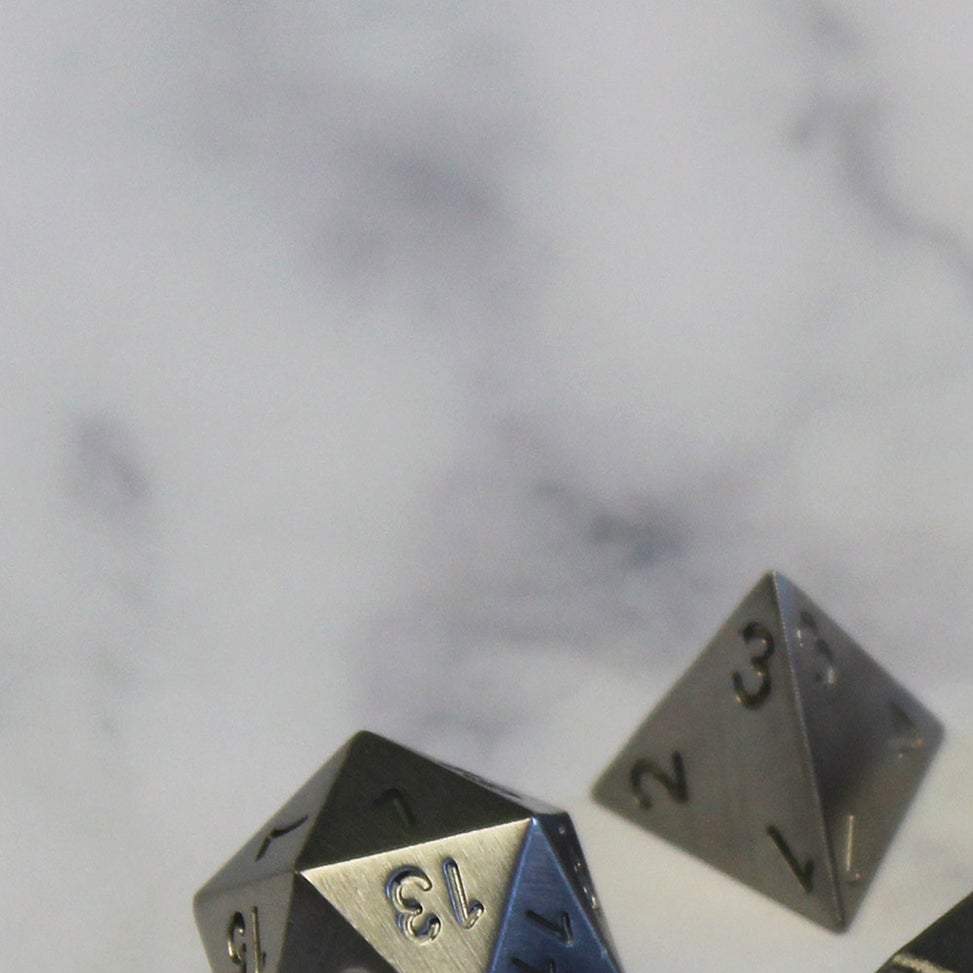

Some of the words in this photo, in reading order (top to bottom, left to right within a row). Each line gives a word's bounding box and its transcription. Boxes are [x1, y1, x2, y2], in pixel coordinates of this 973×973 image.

[732, 622, 776, 710] 3
[629, 750, 689, 810] 2
[767, 824, 815, 894] 1
[385, 857, 485, 944] 13
